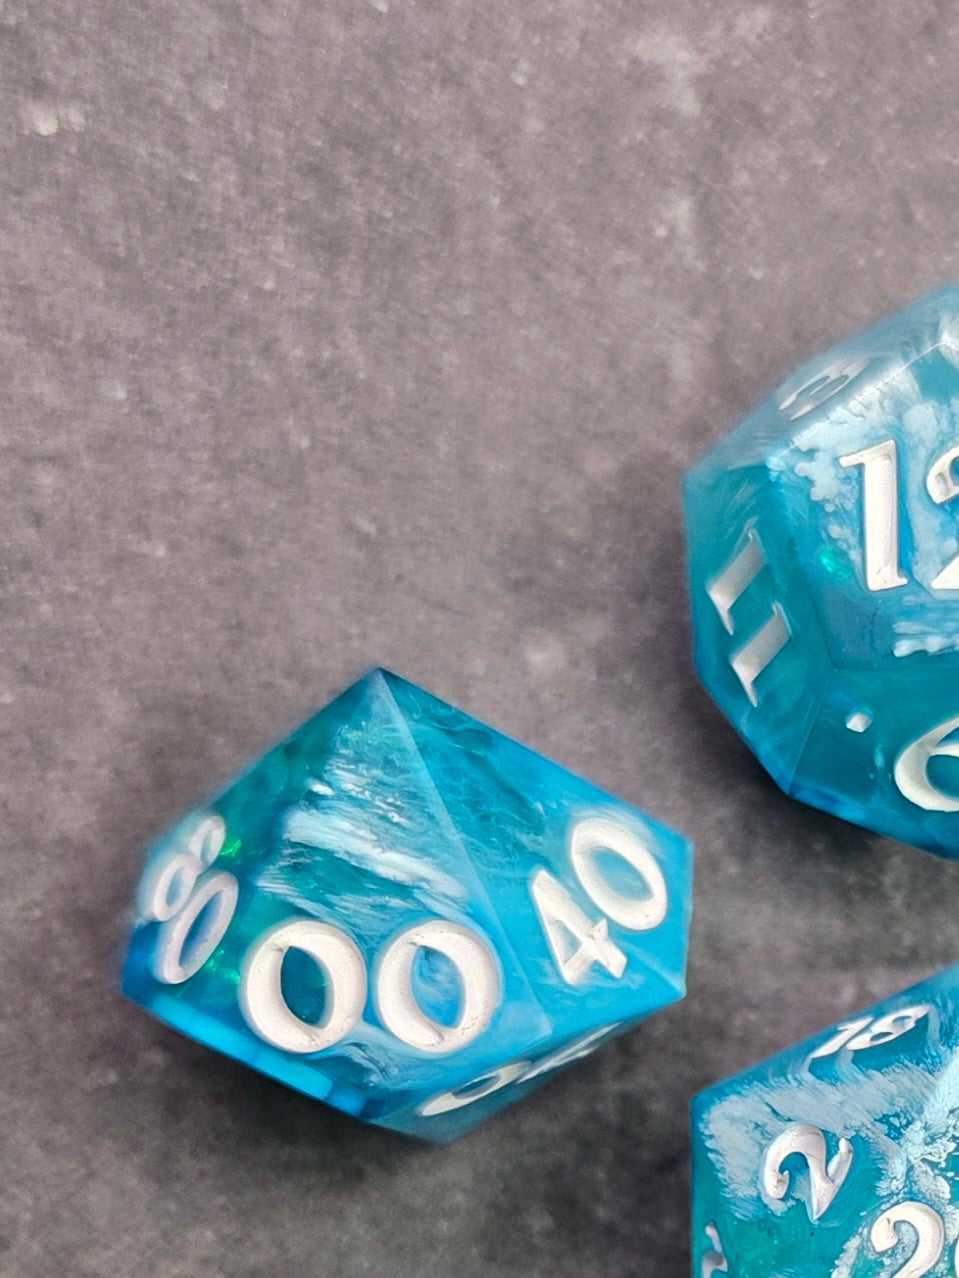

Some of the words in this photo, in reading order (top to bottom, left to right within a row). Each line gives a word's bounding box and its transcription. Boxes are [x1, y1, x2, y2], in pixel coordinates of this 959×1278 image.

[151, 815, 239, 985] 80
[531, 816, 667, 985] 40
[244, 920, 498, 1054] 00
[762, 1124, 853, 1221] 2
